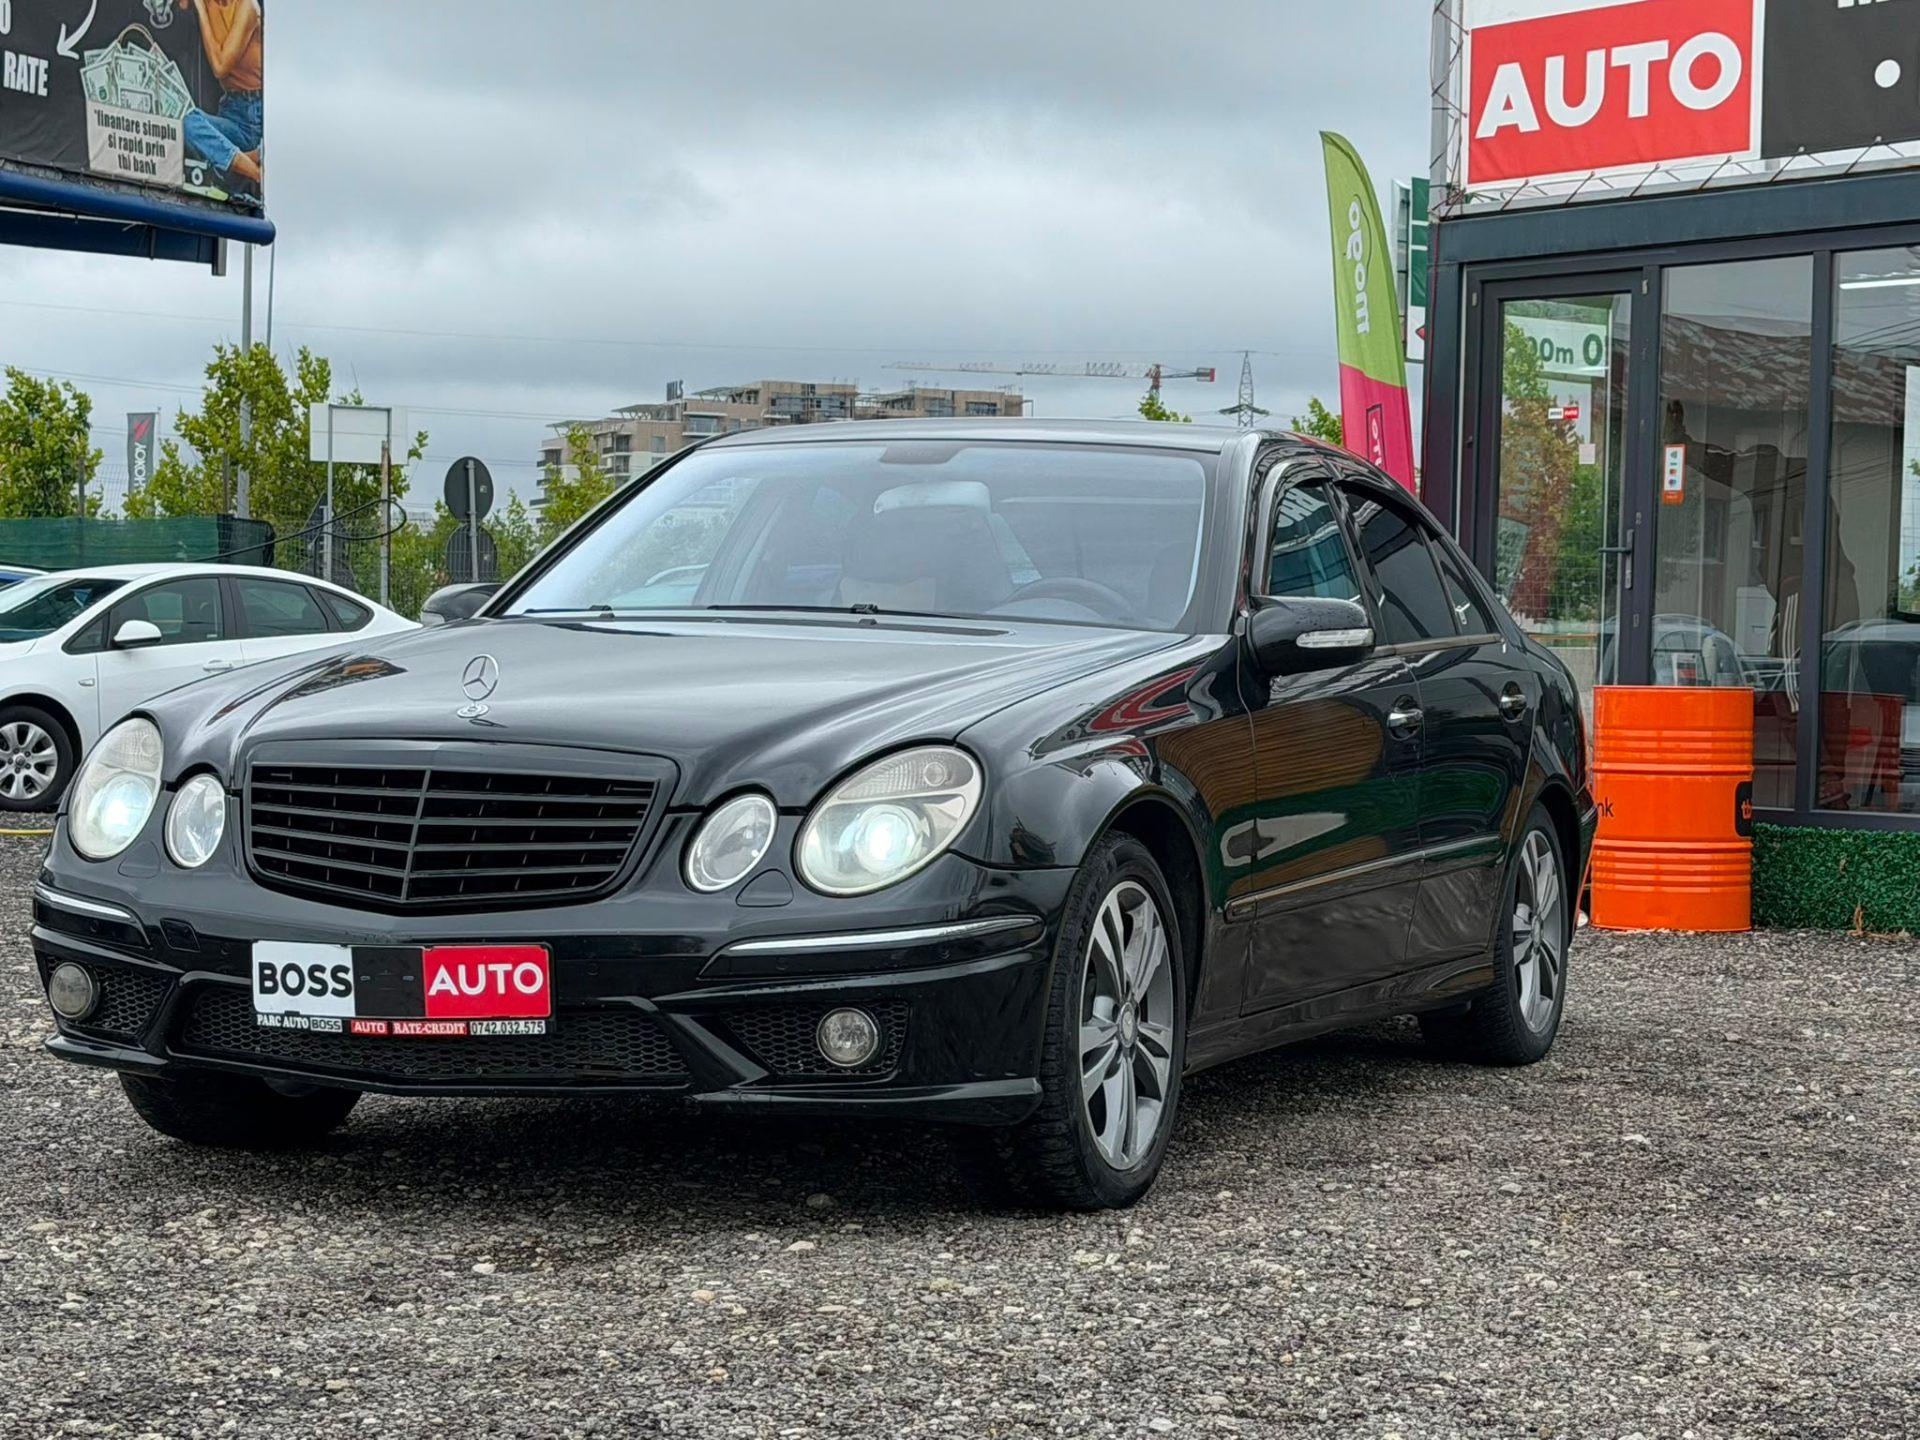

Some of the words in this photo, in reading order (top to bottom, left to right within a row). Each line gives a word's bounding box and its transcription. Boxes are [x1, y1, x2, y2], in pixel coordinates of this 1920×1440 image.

[3, 50, 49, 97] RATE
[1474, 31, 1742, 139] AUTO
[142, 120, 177, 141] simplu
[108, 133, 116, 149] si
[118, 136, 143, 154] rapid
[145, 140, 165, 158] prin
[133, 156, 156, 175] bank
[258, 961, 353, 997] BOSS
[428, 961, 544, 997] AUTO
[257, 1014, 281, 1028] PARC
[283, 1016, 309, 1029] AUTO
[311, 1018, 341, 1031] BOSS
[354, 1021, 386, 1033] AUTO
[393, 1021, 466, 1035] RATE-CREDIT
[471, 1021, 544, 1035] 0742.032.575
